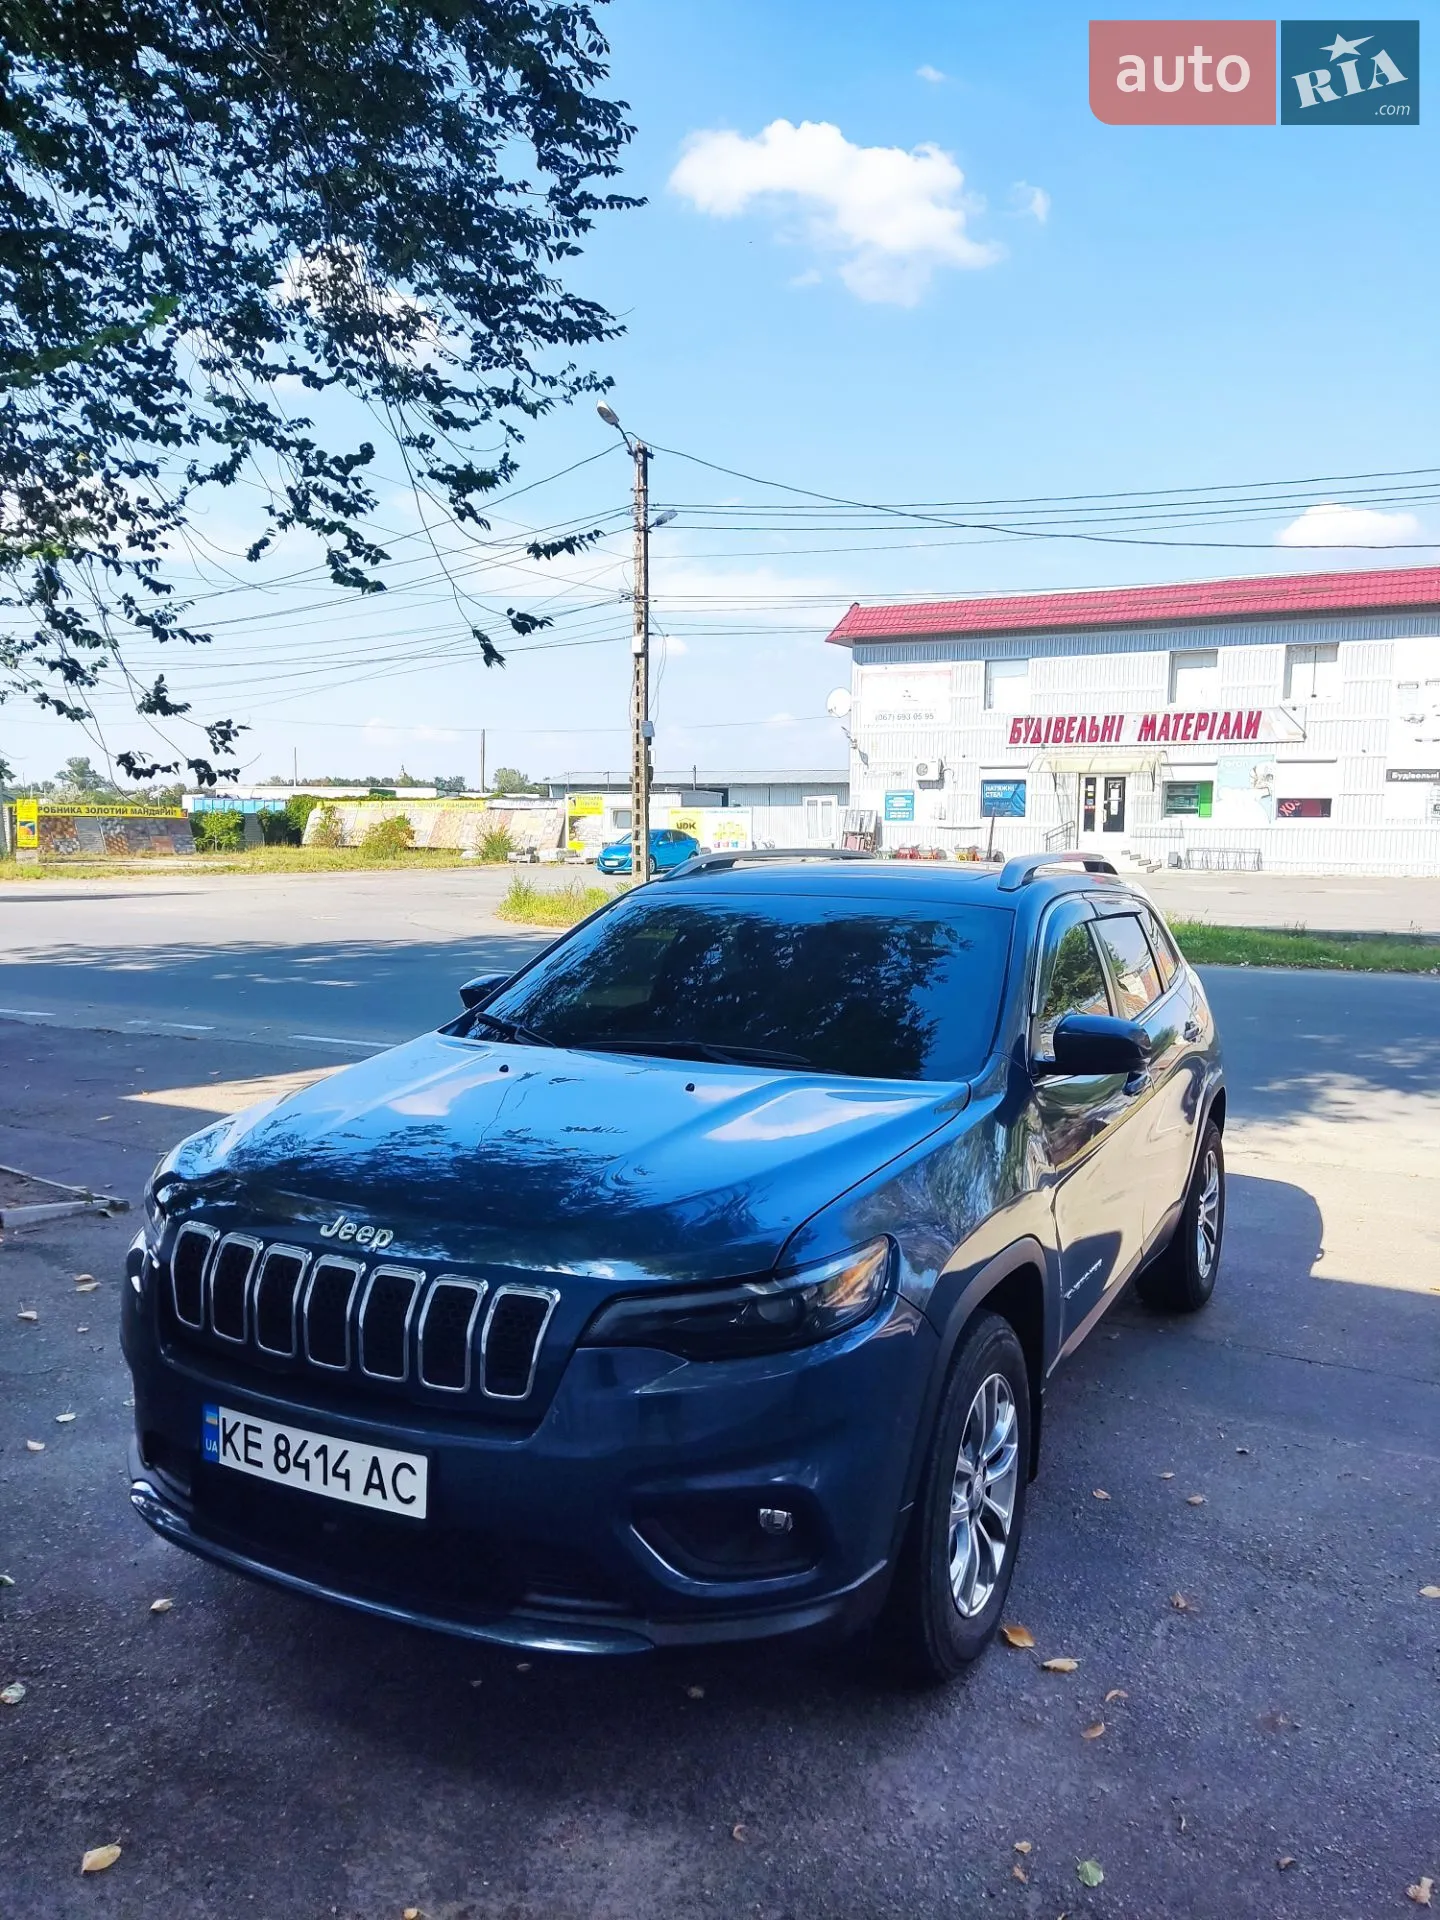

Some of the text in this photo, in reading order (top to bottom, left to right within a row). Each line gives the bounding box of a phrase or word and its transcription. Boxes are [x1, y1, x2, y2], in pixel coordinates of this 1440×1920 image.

[1008, 710, 1263, 744] БУДІВЕЛЬНІ МАТЕРІАЛИ
[85, 806, 129, 815] ЗОЛОТИЙ
[676, 821, 697, 830] UDK
[320, 1215, 394, 1253] Jeep
[205, 1438, 218, 1454] UA
[221, 1417, 418, 1506] KE 8414 AC
